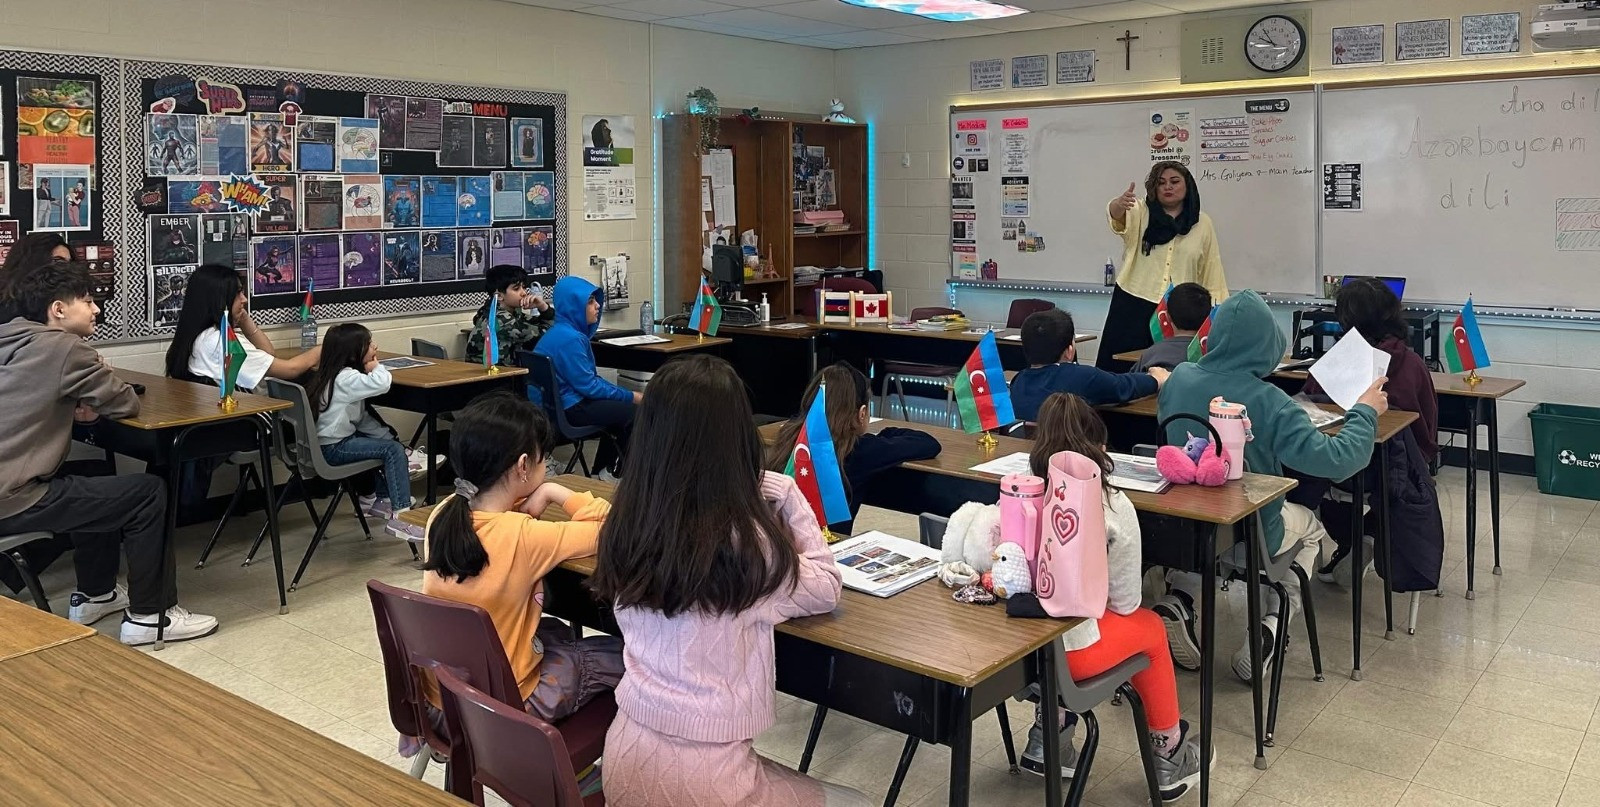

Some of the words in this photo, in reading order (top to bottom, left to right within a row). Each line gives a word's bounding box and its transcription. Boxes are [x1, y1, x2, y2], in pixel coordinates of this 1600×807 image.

[474, 103, 508, 116] MENU
[1502, 86, 1544, 114] Ana
[222, 181, 268, 206] WHAM!
[160, 218, 192, 230] EMBER
